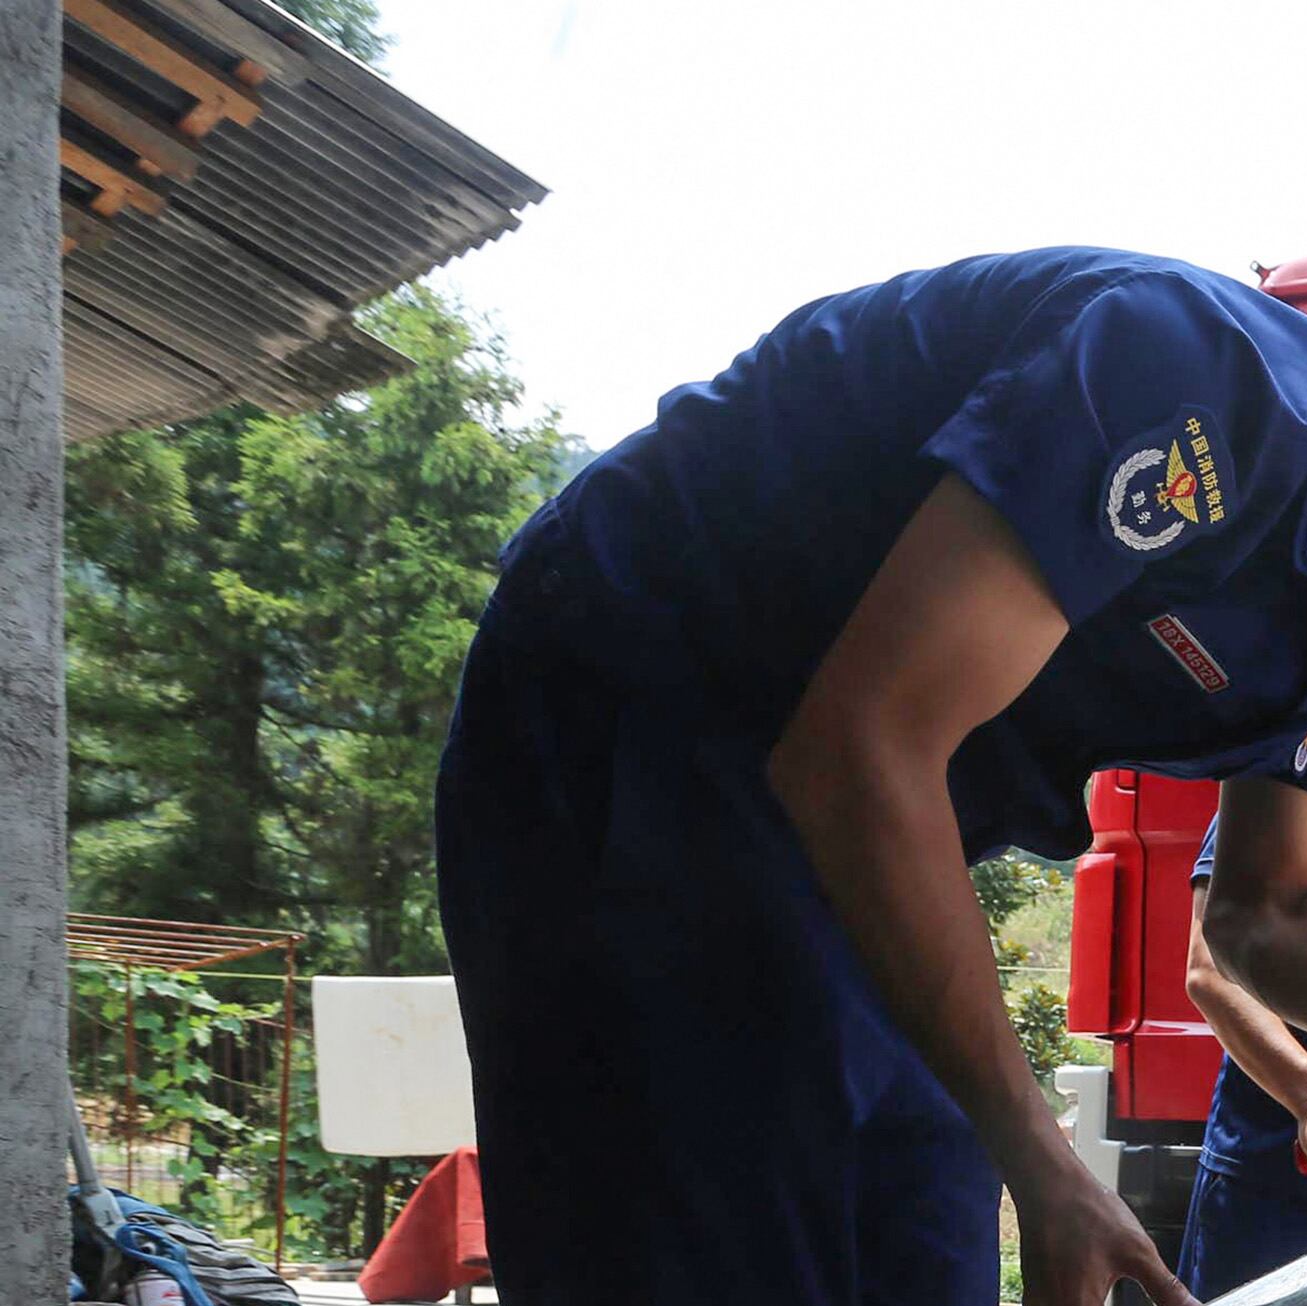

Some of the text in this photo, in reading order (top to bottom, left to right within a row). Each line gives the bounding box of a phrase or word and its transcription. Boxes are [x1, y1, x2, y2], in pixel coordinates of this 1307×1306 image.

[1185, 417, 1225, 524] 中国消防救援
